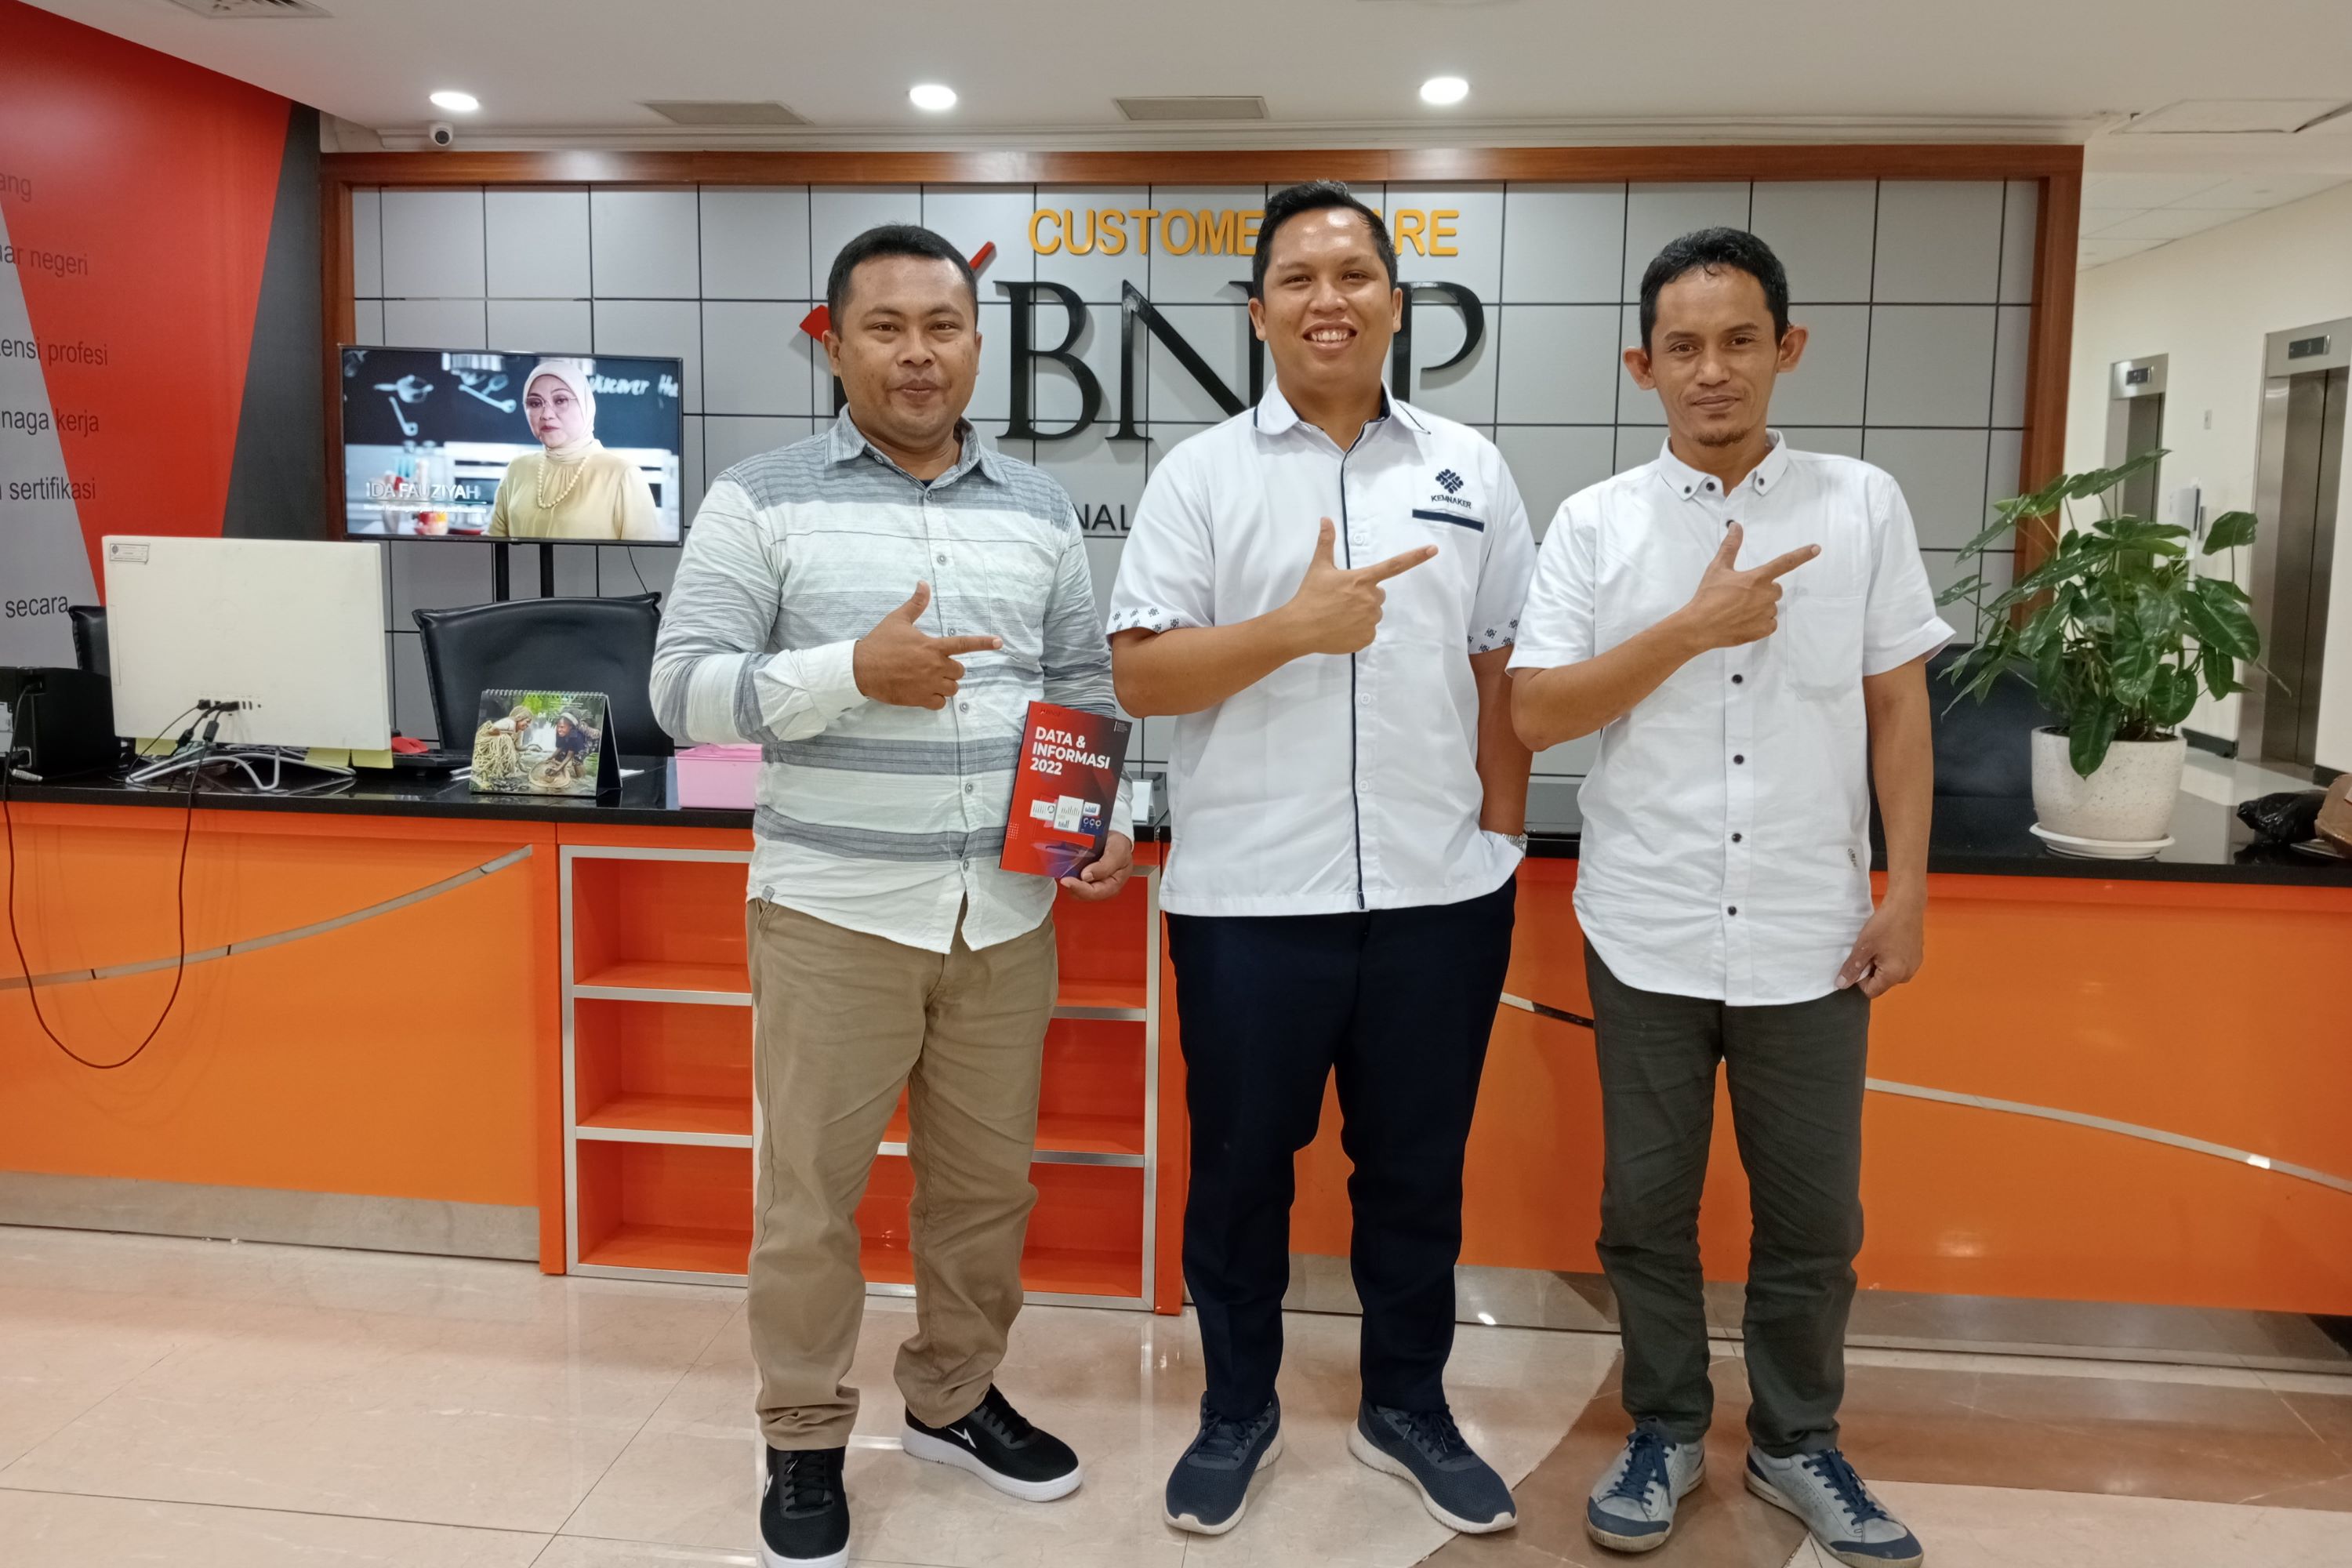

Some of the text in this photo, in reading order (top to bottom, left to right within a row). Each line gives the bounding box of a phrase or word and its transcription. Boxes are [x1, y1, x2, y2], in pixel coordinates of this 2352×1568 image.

[1028, 209, 1265, 256] CUSTOME
[30, 249, 88, 278] negeri
[0, 336, 108, 366] ensi profesi
[993, 280, 1485, 441] BNP
[56, 408, 99, 437] kerja
[9, 477, 96, 500] sertifikasi
[366, 482, 481, 499] IDA FAUZIYAH
[1431, 495, 1472, 509] KEMNAKER
[5, 596, 68, 618] secara
[1035, 726, 1086, 749] DATA &
[1030, 757, 1062, 775] 2022
[1033, 742, 1110, 769] INFORMASI
